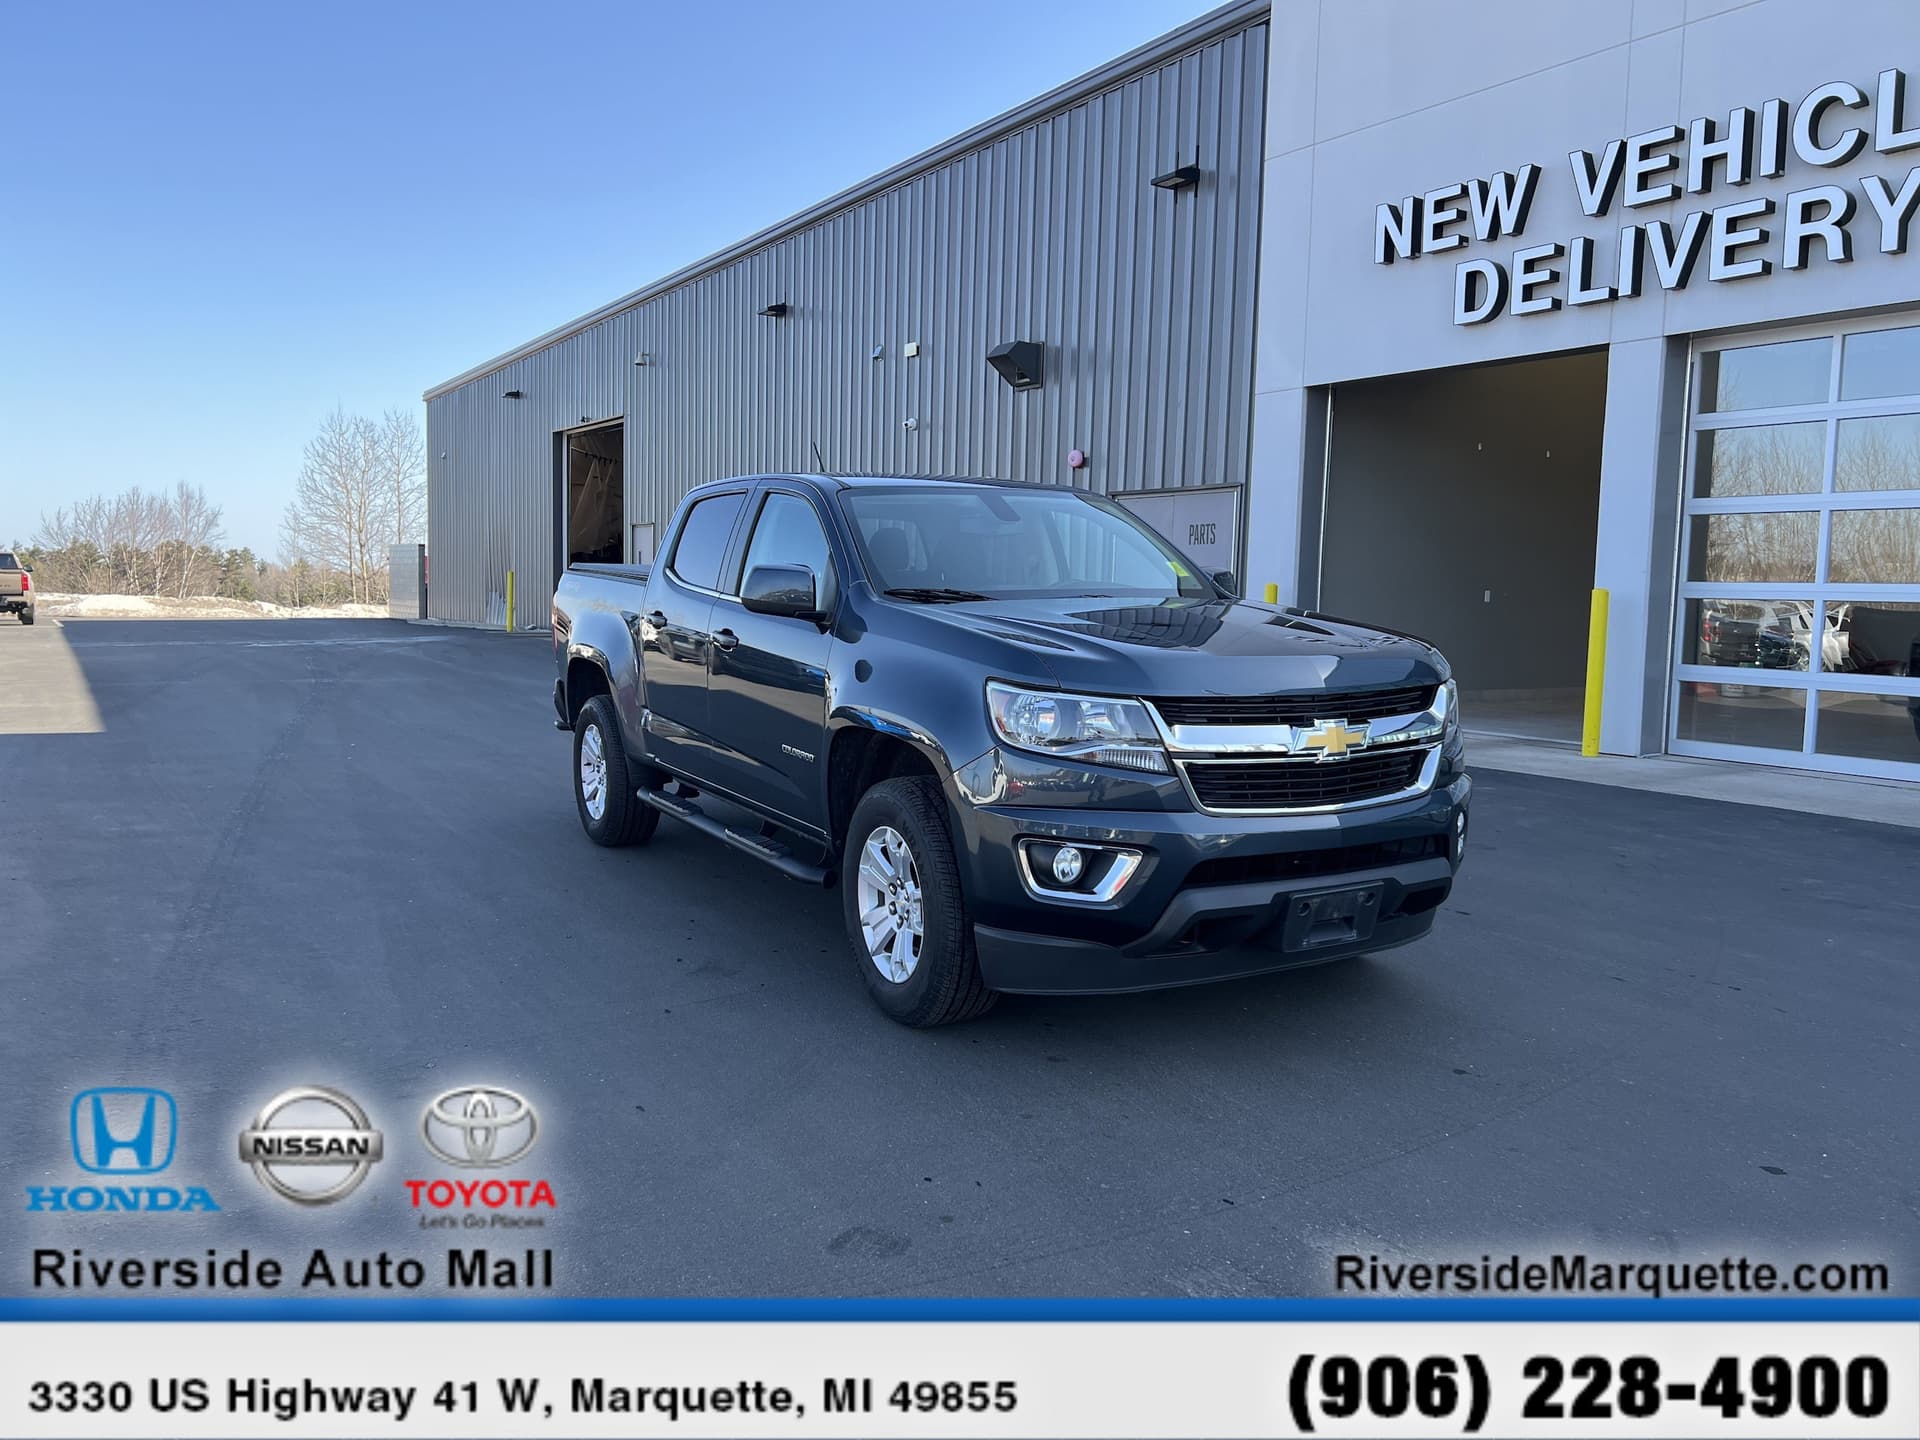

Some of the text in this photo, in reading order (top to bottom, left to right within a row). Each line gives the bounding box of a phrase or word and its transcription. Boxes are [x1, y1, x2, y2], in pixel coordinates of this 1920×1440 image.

[1374, 68, 1920, 265] NEW VEHICL
[1453, 166, 1920, 326] DELIVERY
[1188, 523, 1216, 545] PARTS
[781, 744, 815, 763] COLORADO
